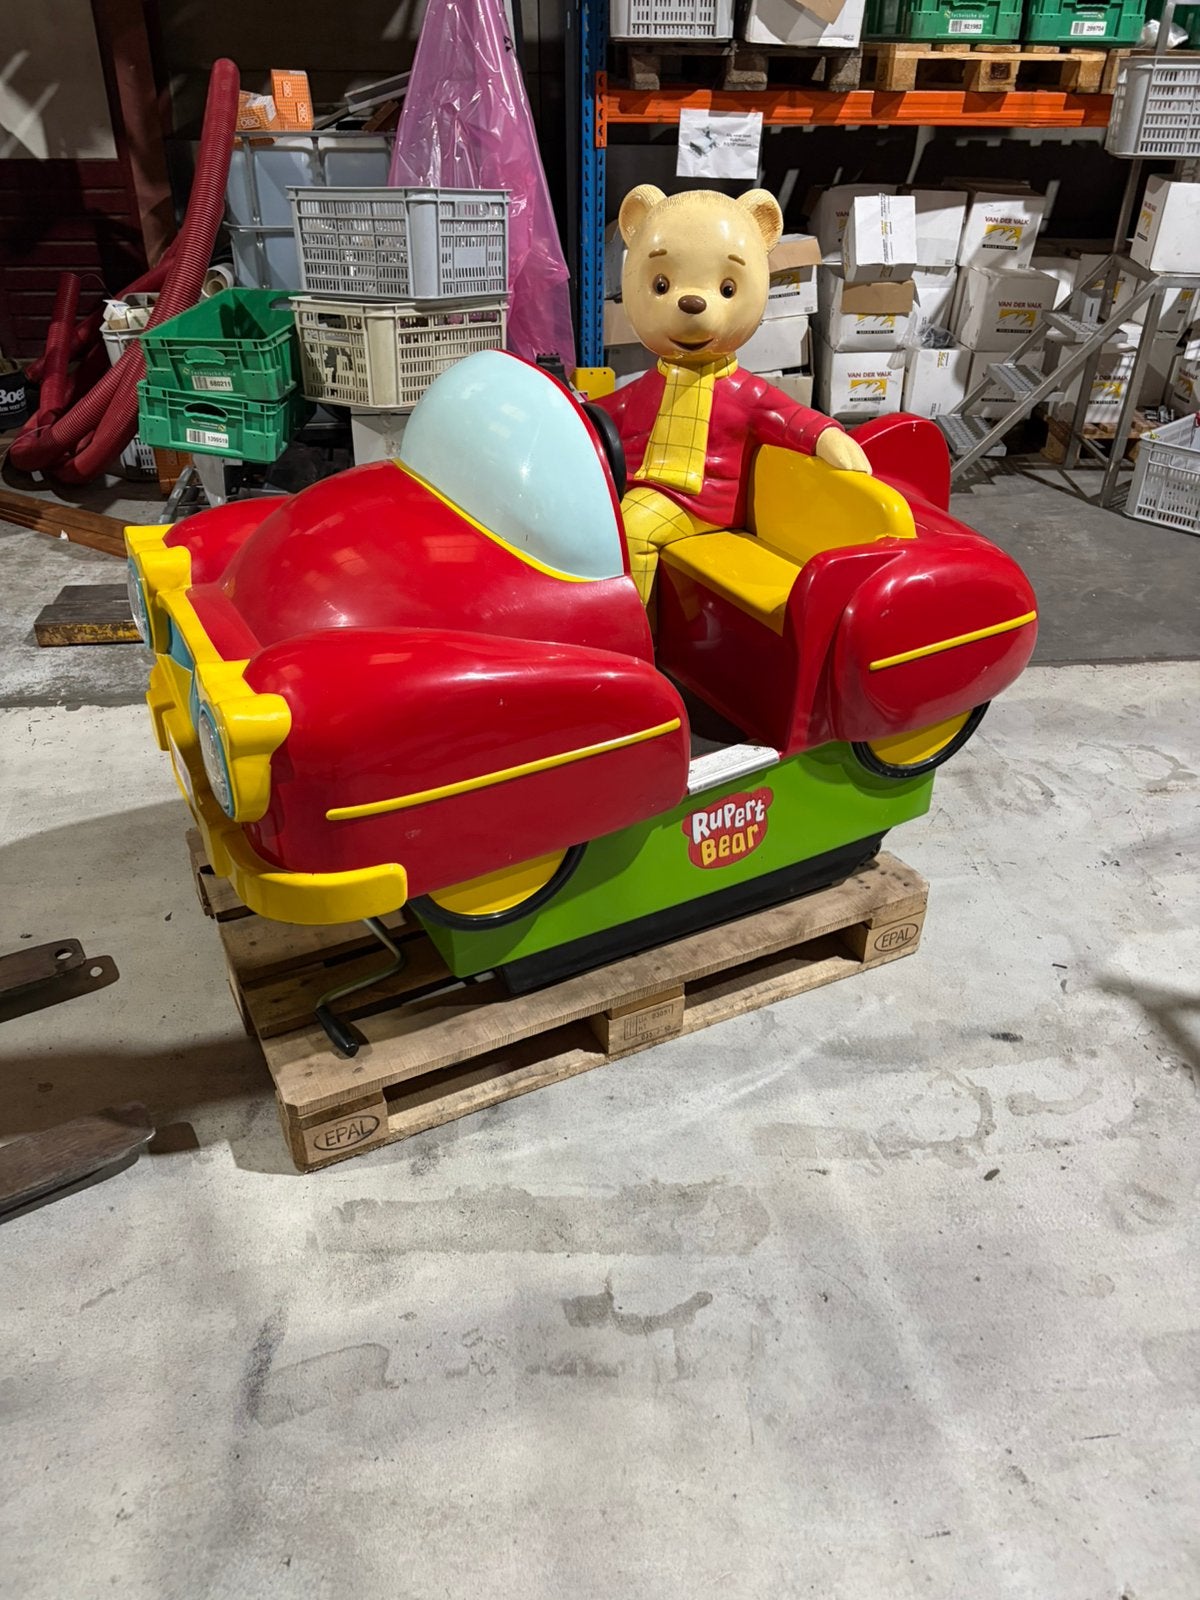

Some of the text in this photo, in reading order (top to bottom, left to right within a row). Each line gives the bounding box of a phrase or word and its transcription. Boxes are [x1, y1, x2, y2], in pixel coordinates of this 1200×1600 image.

[210, 380, 232, 388] 680211
[701, 824, 759, 866] Bear
[881, 928, 912, 948] EPAL
[324, 1120, 373, 1148] EPAL
